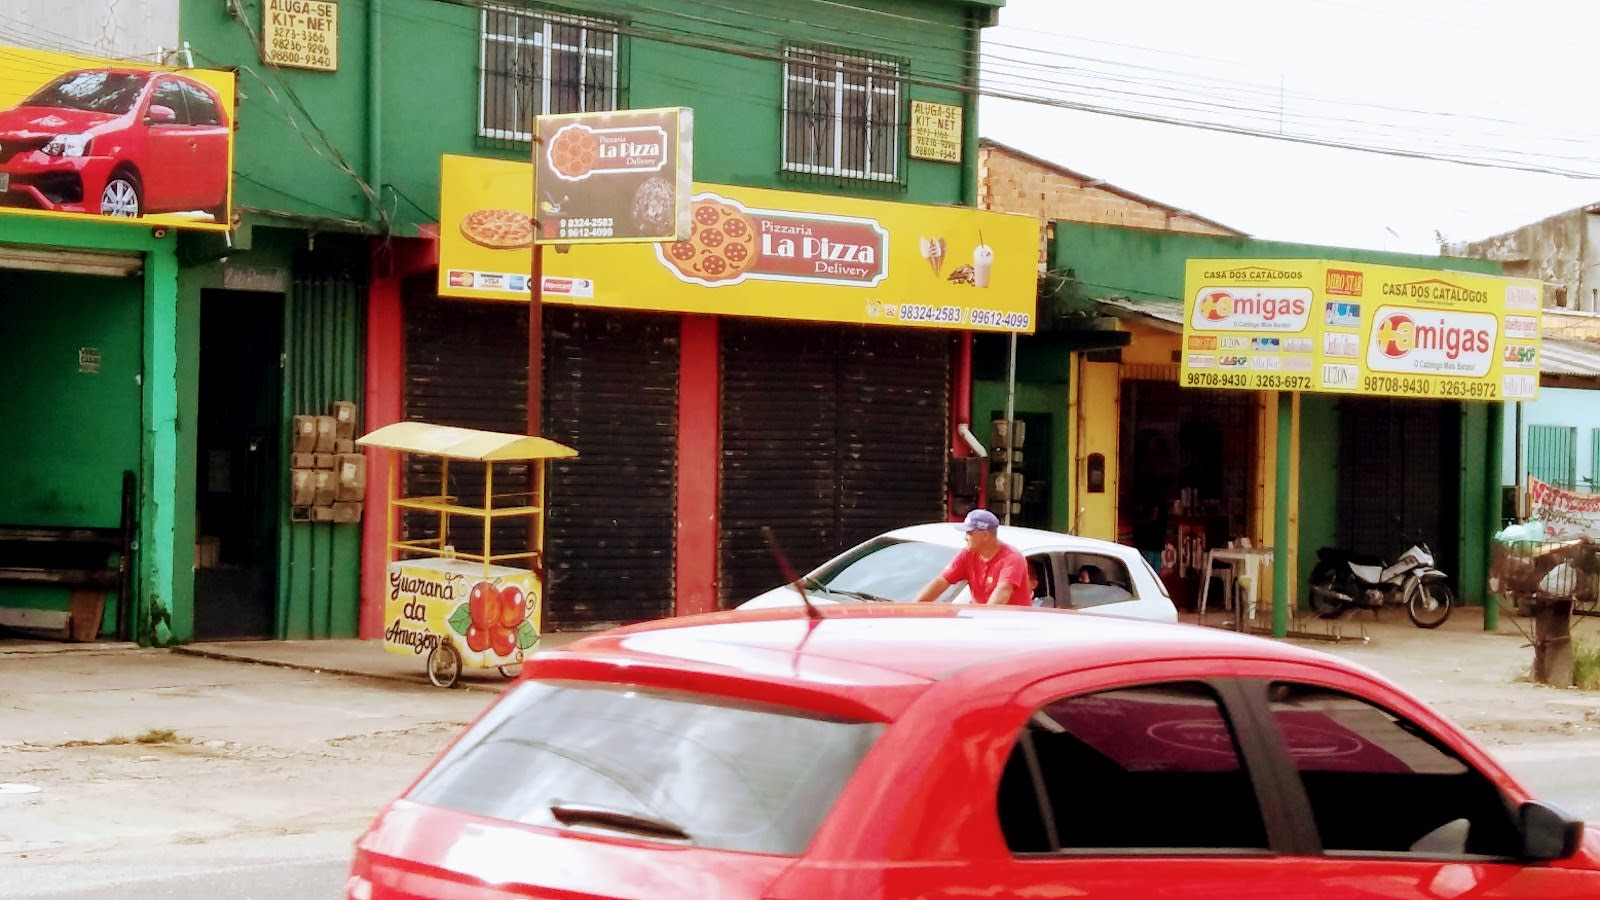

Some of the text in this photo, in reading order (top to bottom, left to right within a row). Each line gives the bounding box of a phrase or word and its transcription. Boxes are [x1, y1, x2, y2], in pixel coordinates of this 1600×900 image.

[270, 0, 332, 17] ALUGA-SE
[600, 142, 660, 158] La Pizza
[761, 220, 812, 235] Pizzaria
[762, 233, 875, 264] La Pizza
[815, 261, 869, 277] Delivery
[1204, 271, 1227, 279] CASA
[1229, 271, 1247, 280] DOS
[1382, 282, 1408, 297] CASA
[1410, 284, 1430, 299] DOS
[900, 305, 961, 322] 98324-2583
[971, 309, 1029, 328] 99612-4099
[1187, 373, 1247, 386] 98708-9430
[1256, 375, 1311, 389] 3263-6972
[1364, 376, 1430, 394] 98708-9430
[1440, 380, 1497, 398] 3263-6972
[390, 567, 455, 601] Guaraná
[403, 595, 426, 622] da
